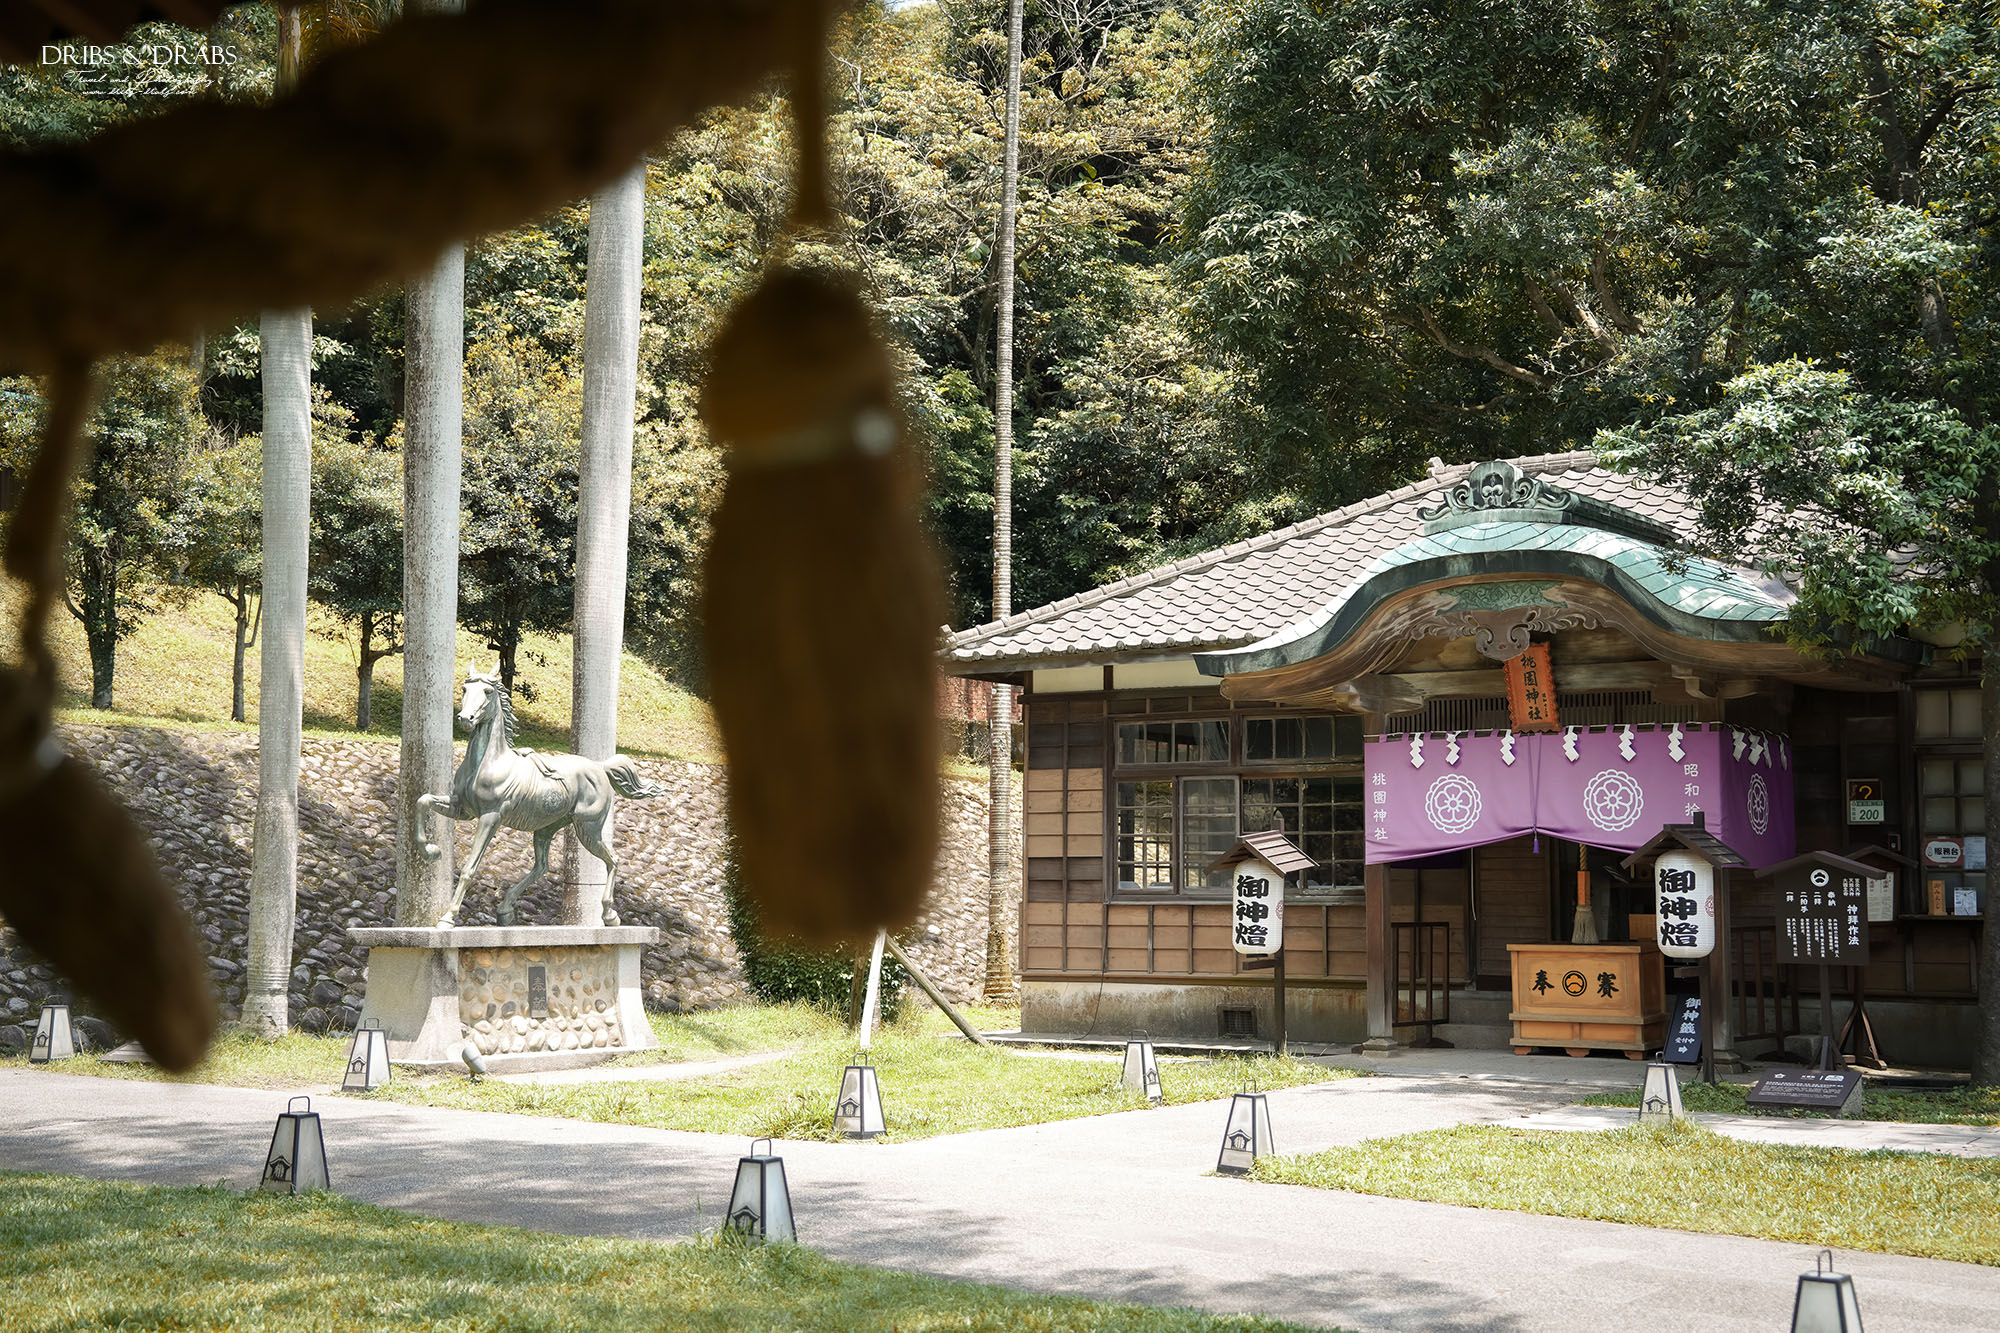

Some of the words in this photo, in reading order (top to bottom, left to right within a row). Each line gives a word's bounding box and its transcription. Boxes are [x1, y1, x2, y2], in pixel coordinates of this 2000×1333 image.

[1520, 653, 1543, 721] 桃園神社
[1371, 772, 1389, 841] 桃園神社
[1683, 763, 1701, 822] 昭和拾
[1859, 809, 1880, 820] 200
[1235, 875, 1270, 947] 御神燈
[1659, 868, 1699, 948] 御神燈
[1532, 969, 1555, 996] 奉
